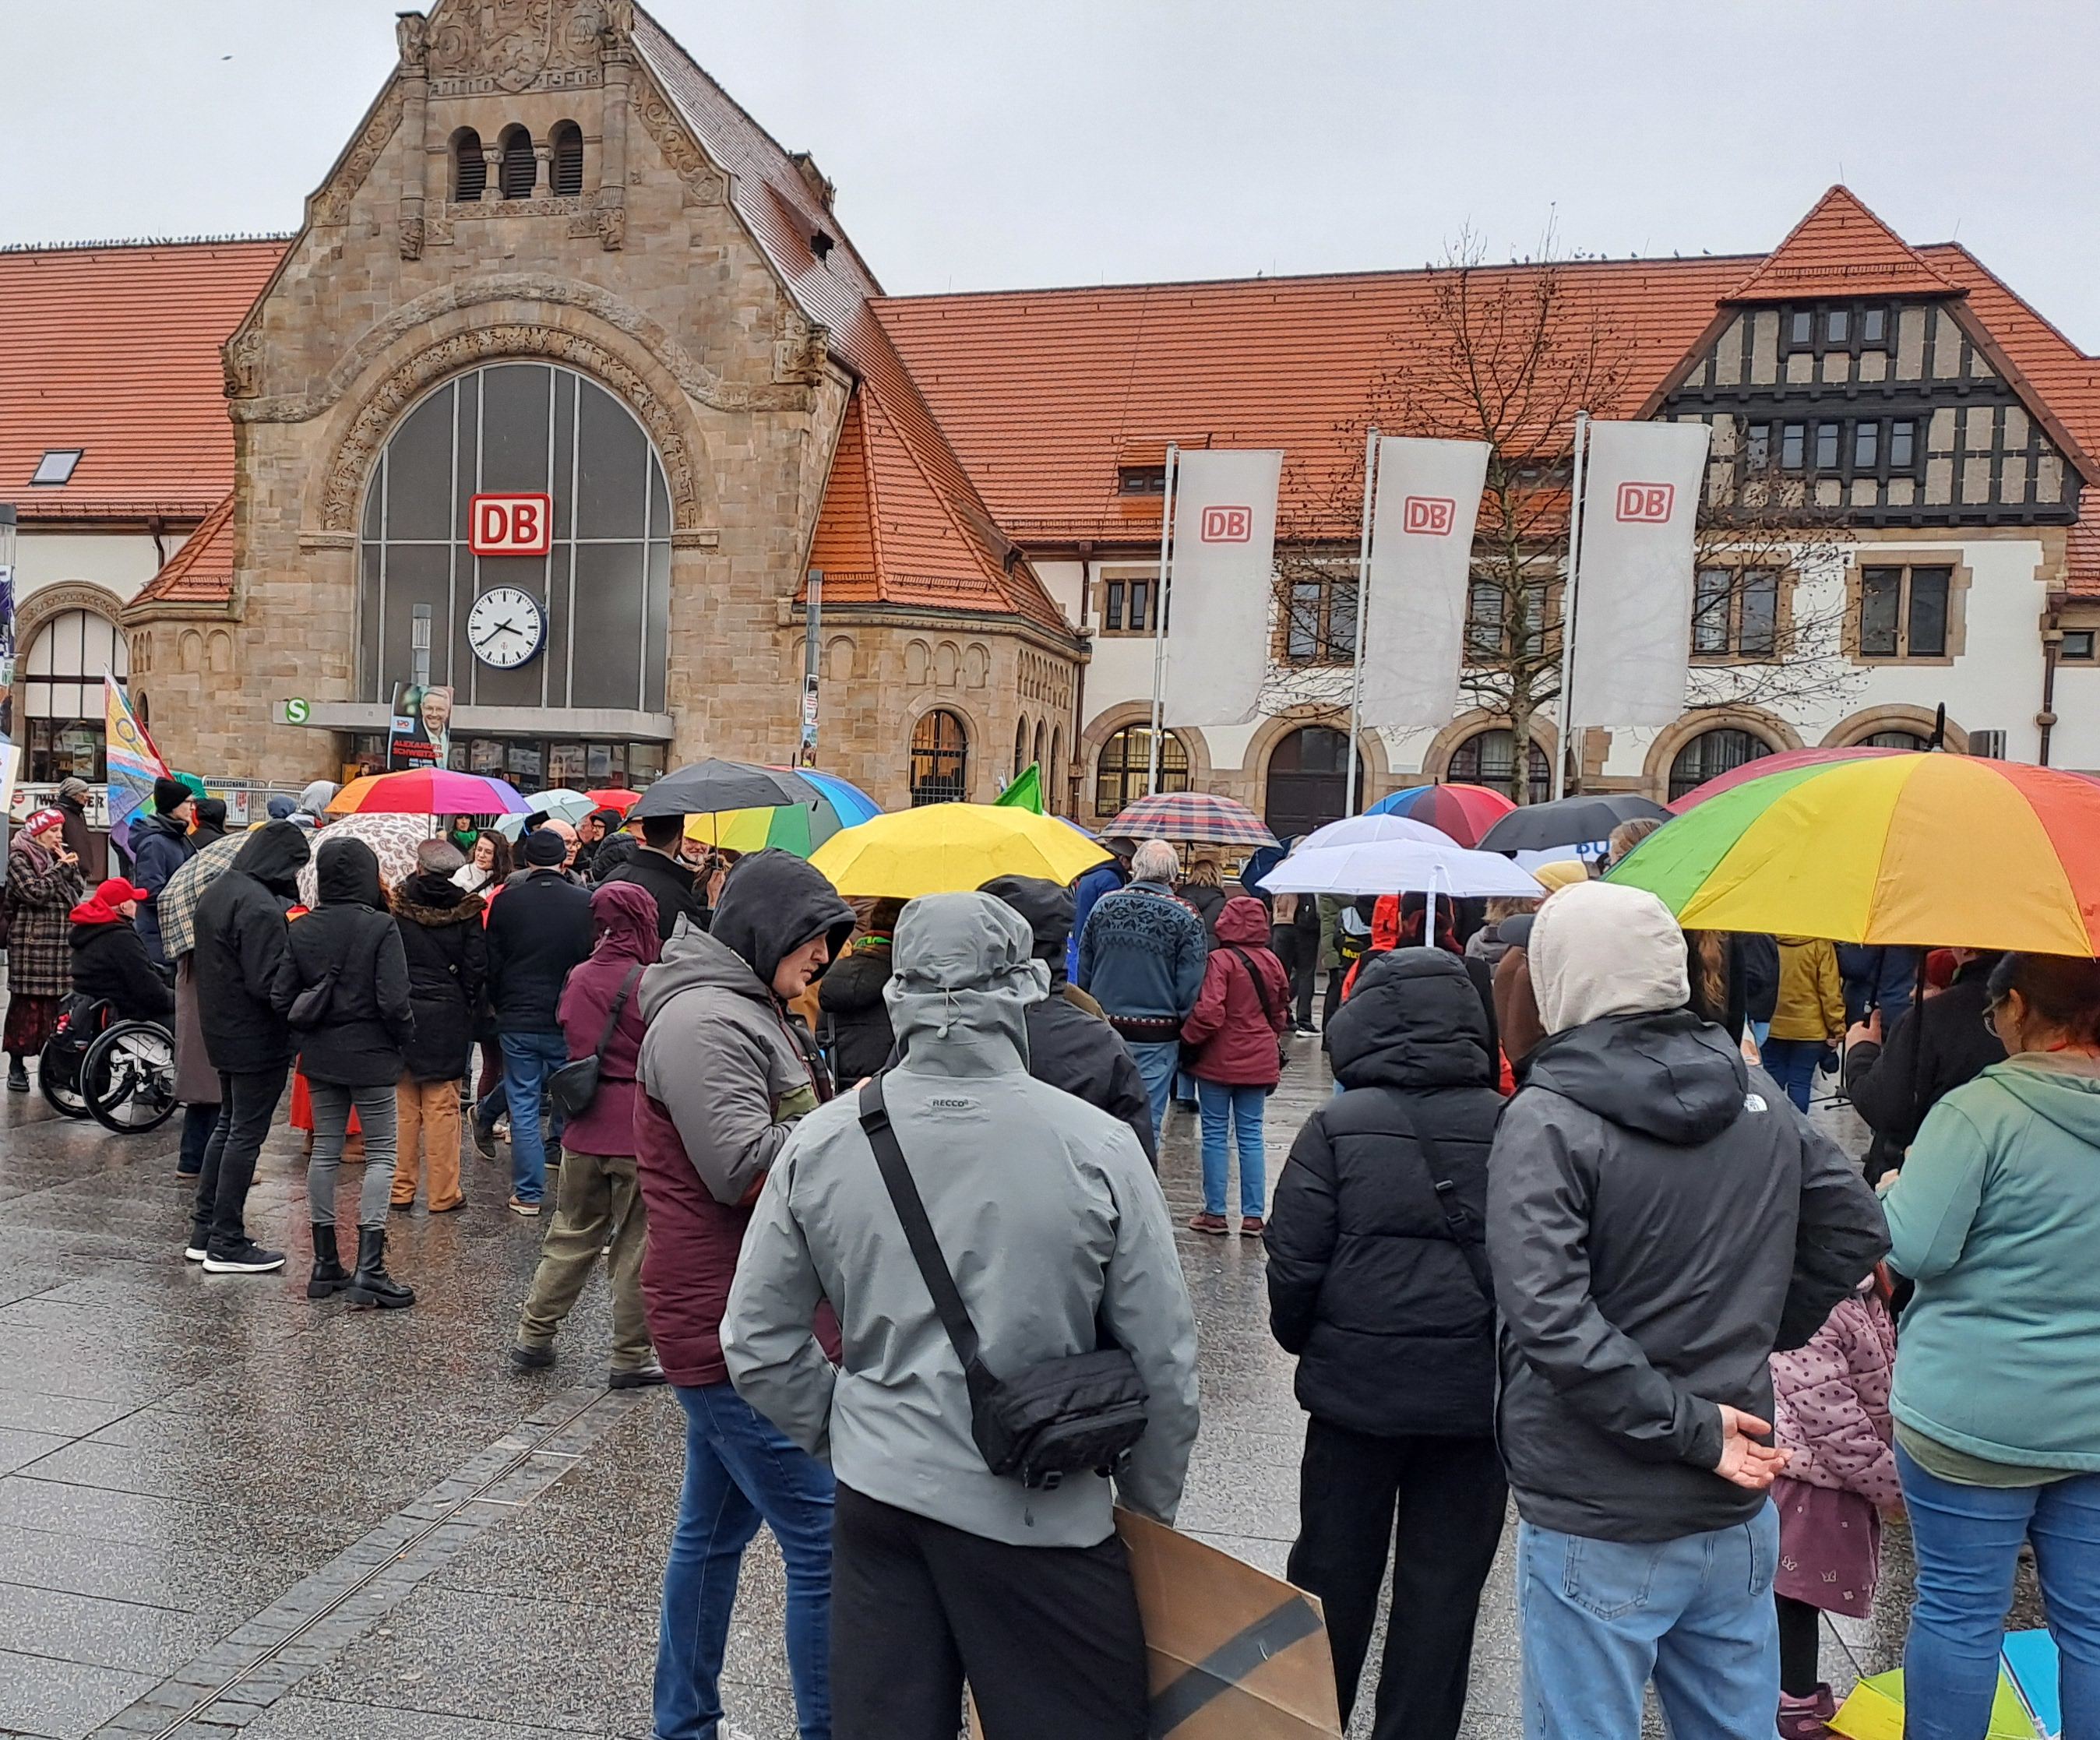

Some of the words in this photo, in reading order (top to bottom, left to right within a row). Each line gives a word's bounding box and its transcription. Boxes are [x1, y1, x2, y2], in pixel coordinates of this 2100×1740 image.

[1624, 488, 1665, 516] DB
[481, 504, 538, 544] DB
[1208, 512, 1245, 536] DB
[1411, 502, 1447, 529] DB
[289, 699, 306, 722] S
[393, 740, 442, 751] ALEXANDER
